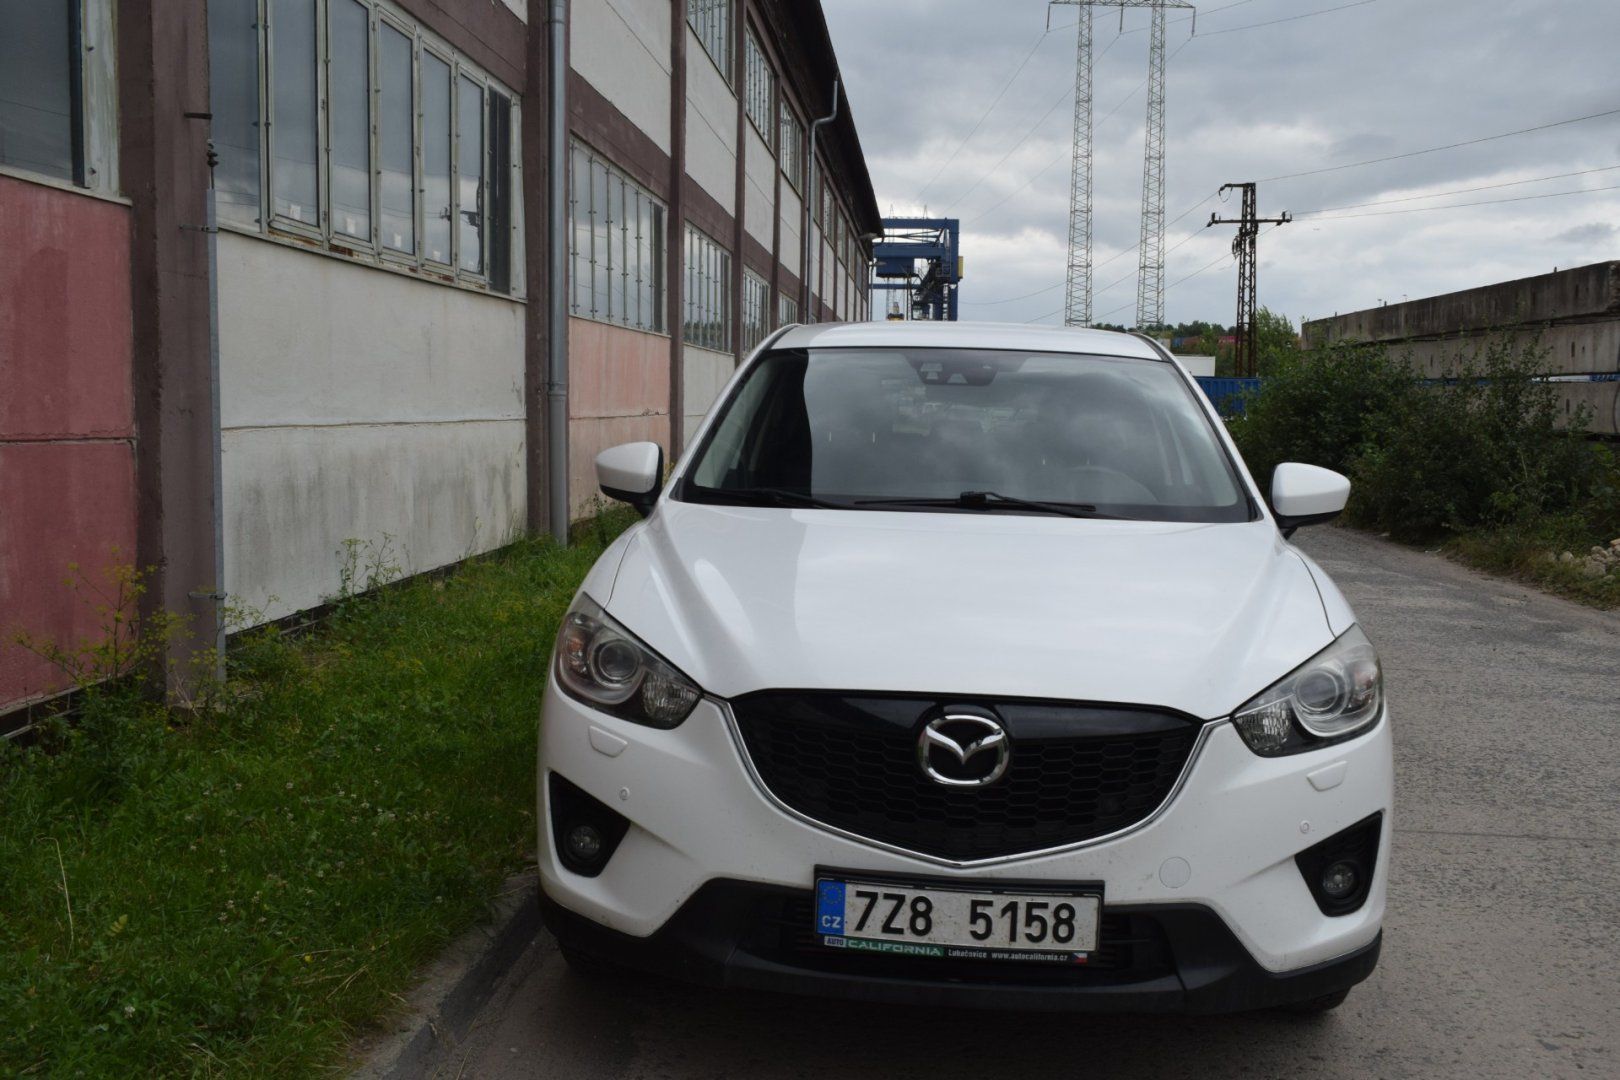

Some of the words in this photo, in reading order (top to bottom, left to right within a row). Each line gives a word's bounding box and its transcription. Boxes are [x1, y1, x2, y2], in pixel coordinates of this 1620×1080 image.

[822, 915, 841, 928] CZ
[854, 890, 933, 937] 7Z8
[969, 899, 1076, 944] 5158
[827, 937, 844, 945] AUTO
[848, 939, 941, 956] CALIFORNIA
